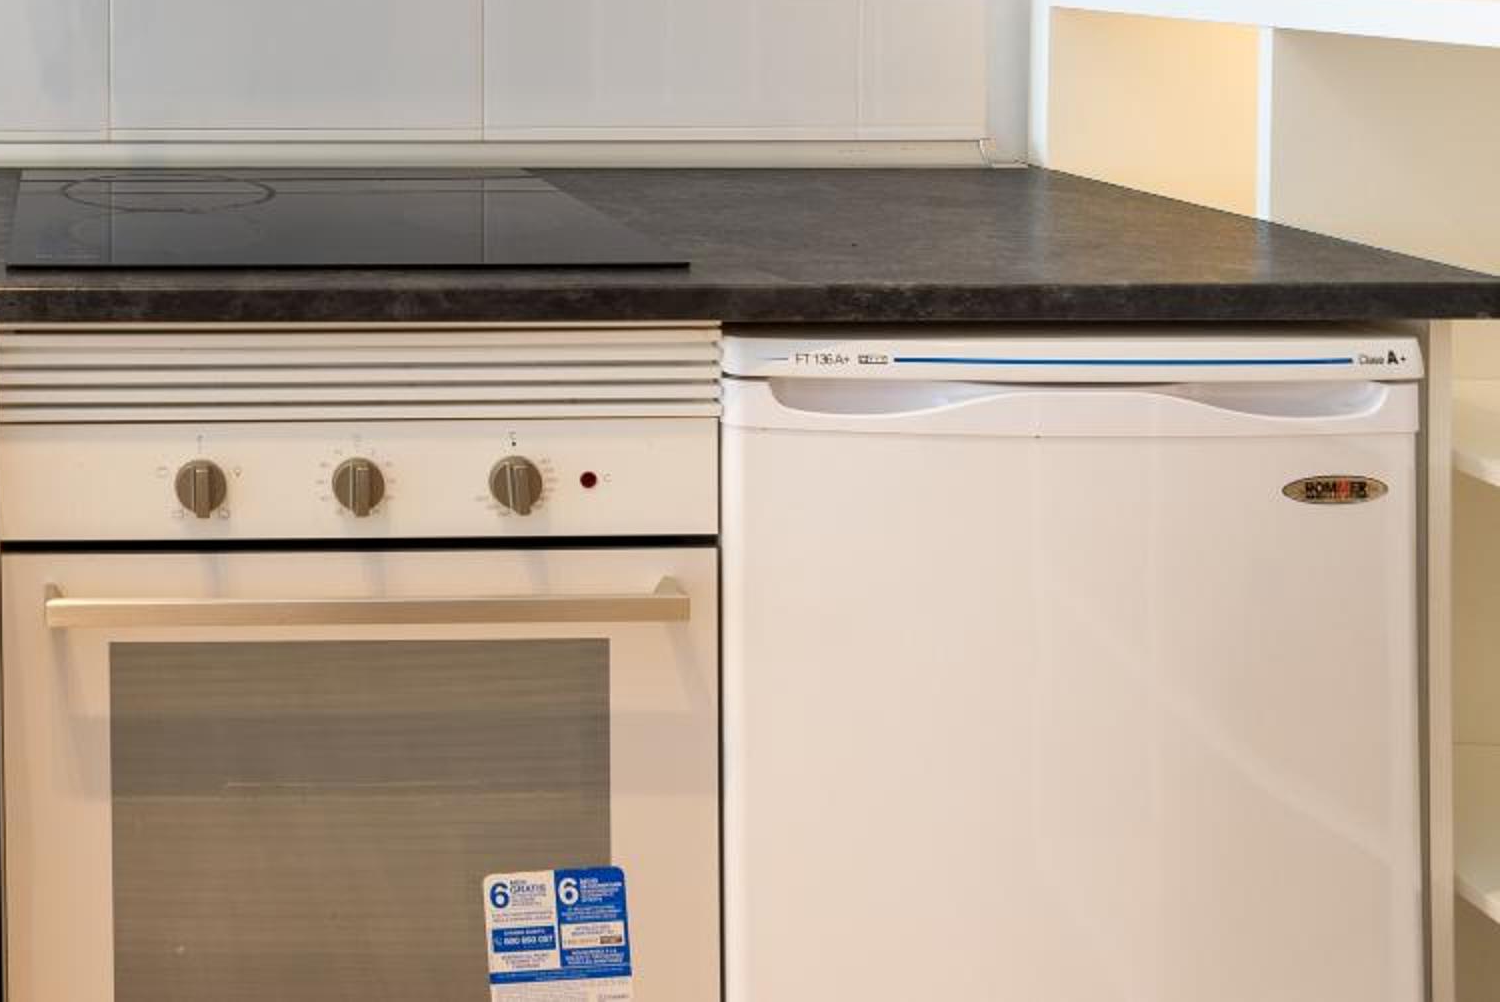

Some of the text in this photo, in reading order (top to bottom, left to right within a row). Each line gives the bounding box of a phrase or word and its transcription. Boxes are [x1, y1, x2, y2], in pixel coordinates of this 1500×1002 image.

[1387, 349, 1407, 365] A+
[489, 881, 510, 909] 6
[557, 877, 579, 906] 6
